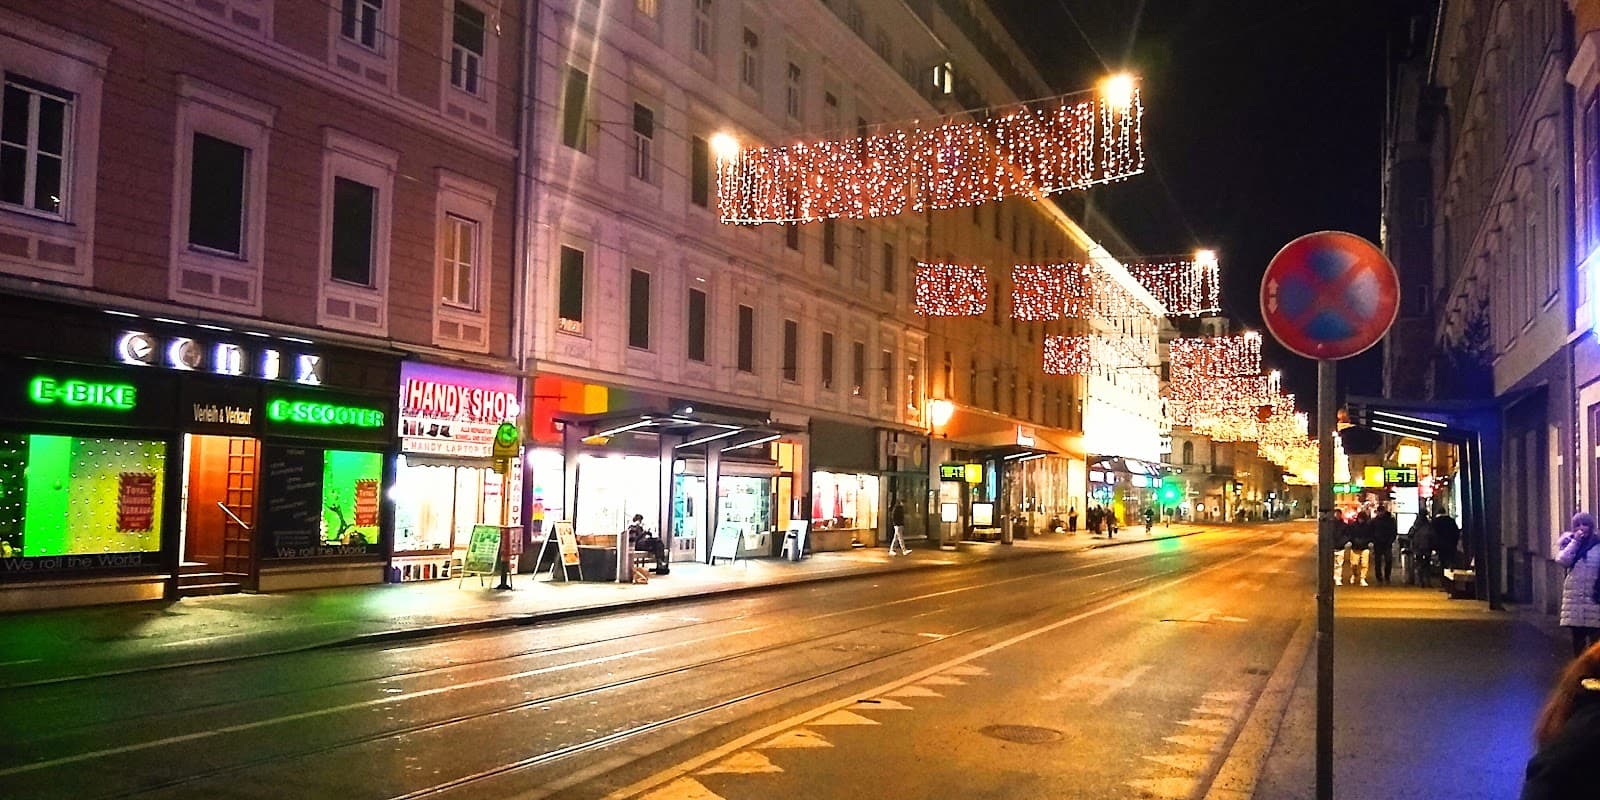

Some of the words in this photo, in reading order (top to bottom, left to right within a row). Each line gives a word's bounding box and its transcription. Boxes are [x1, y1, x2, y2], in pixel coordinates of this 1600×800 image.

[30, 377, 137, 409] E-BIKE
[405, 378, 468, 415] HANDY
[470, 388, 519, 420] SHOP
[193, 403, 218, 422] Verleih
[219, 408, 224, 423] &
[225, 405, 252, 425] Verkauf
[268, 400, 385, 427] E-SCOOTER
[411, 441, 442, 451] HANDY
[4, 558, 34, 571] We
[39, 557, 63, 569] roll
[67, 556, 92, 568] the
[98, 554, 142, 567] World
[277, 547, 296, 557] We
